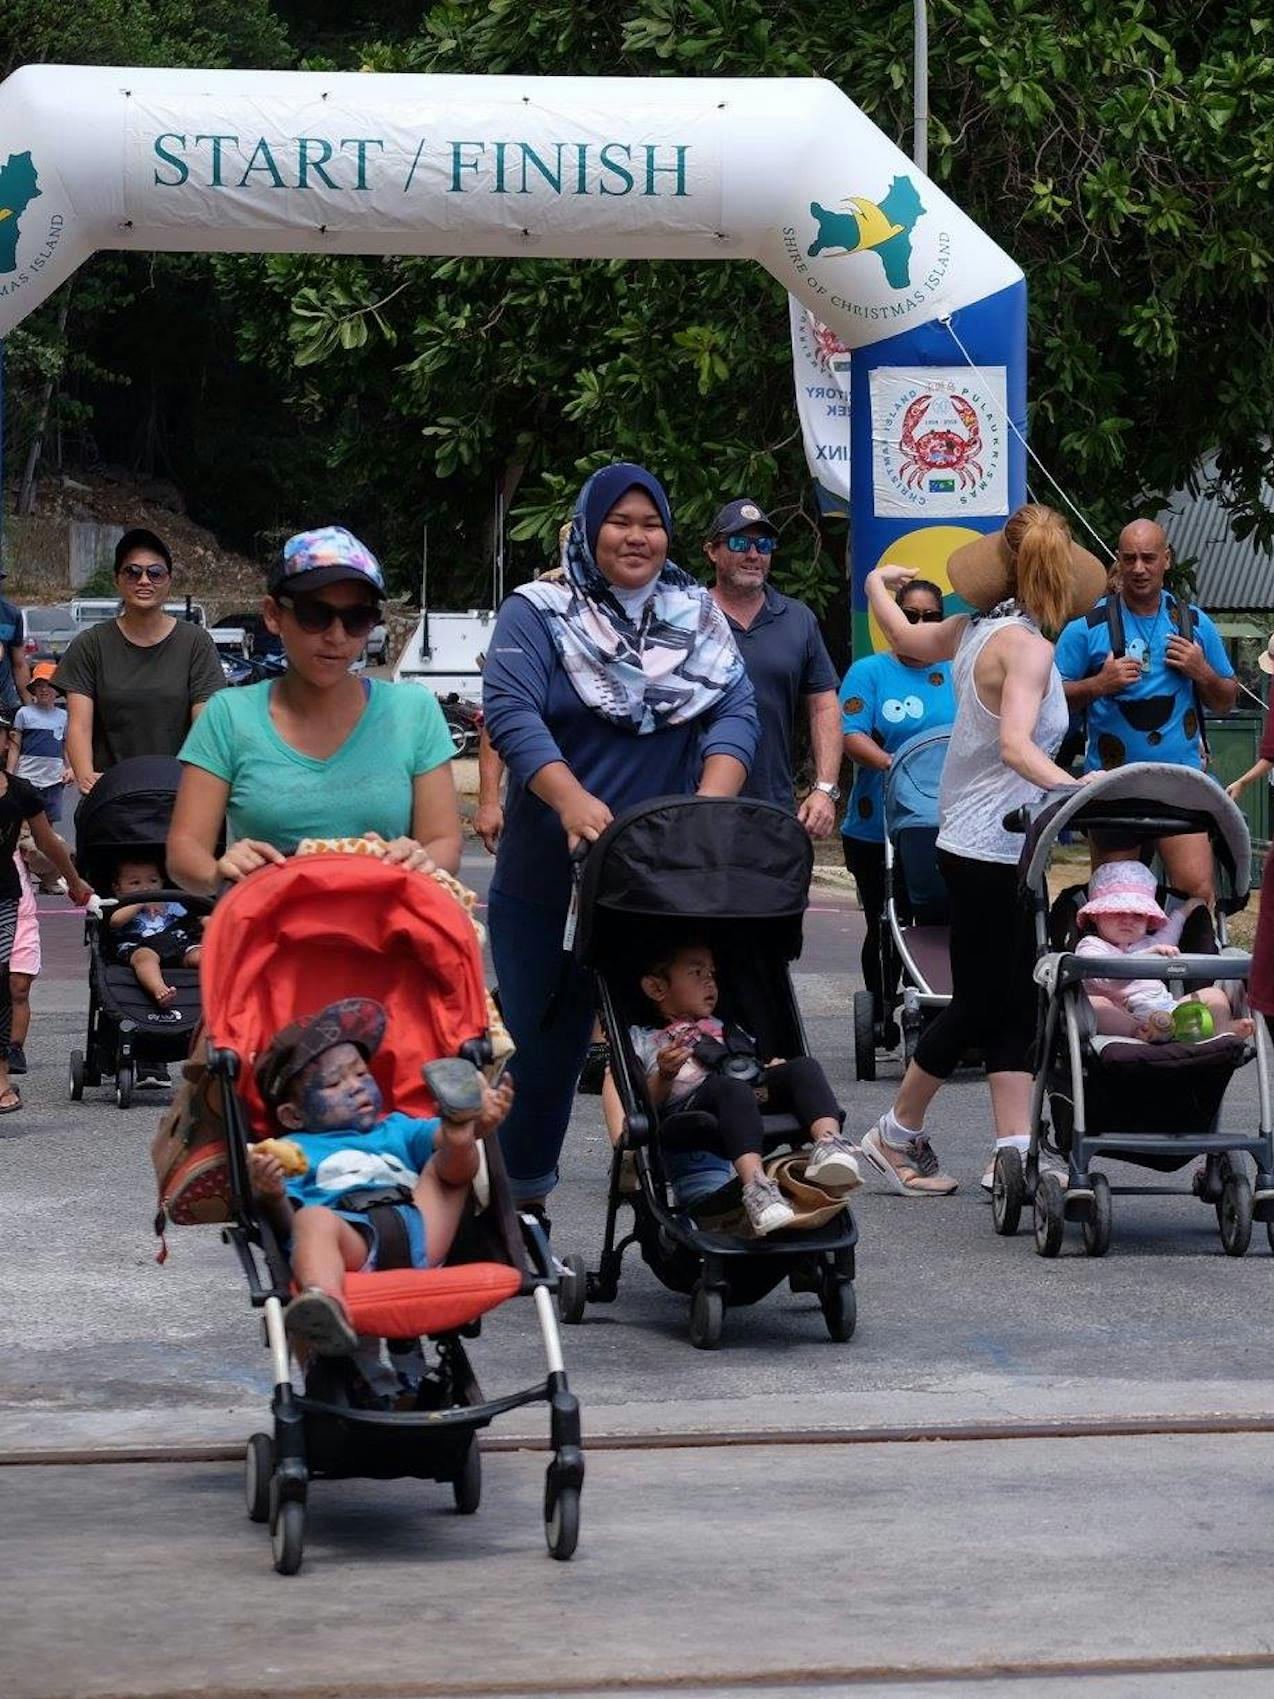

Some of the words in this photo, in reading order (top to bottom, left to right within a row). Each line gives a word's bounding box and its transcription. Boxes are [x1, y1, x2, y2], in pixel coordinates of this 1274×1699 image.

[154, 133, 384, 191] START
[403, 138, 425, 192] /
[447, 141, 693, 196] FINISH
[30, 214, 64, 272] ISLAND
[783, 227, 807, 273] SHIRE
[807, 277, 827, 295] OF
[831, 291, 925, 320] CHRISTMAS
[924, 231, 950, 291] ISLAND
[884, 389, 917, 431] ISLAND
[961, 387, 998, 433] PULAU
[959, 437, 999, 504] KRISMAS
